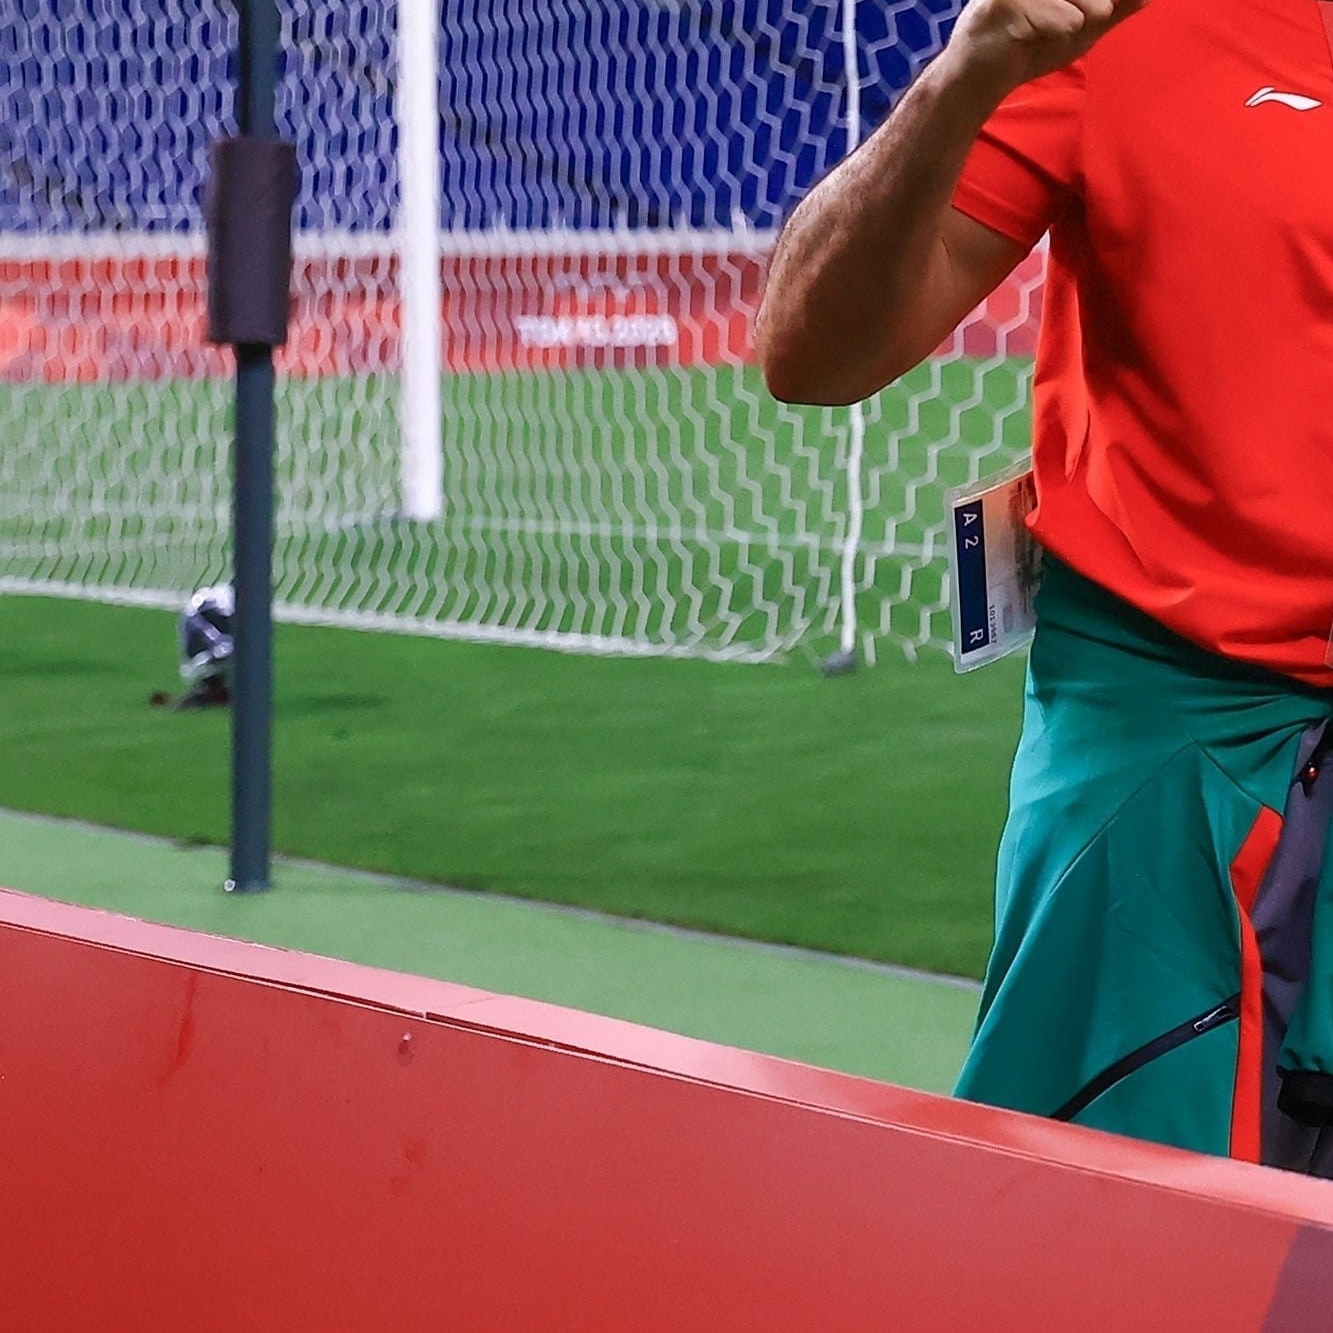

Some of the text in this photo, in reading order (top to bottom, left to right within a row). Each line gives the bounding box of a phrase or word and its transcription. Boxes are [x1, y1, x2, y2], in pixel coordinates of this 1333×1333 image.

[962, 512, 984, 644] A 2 R
